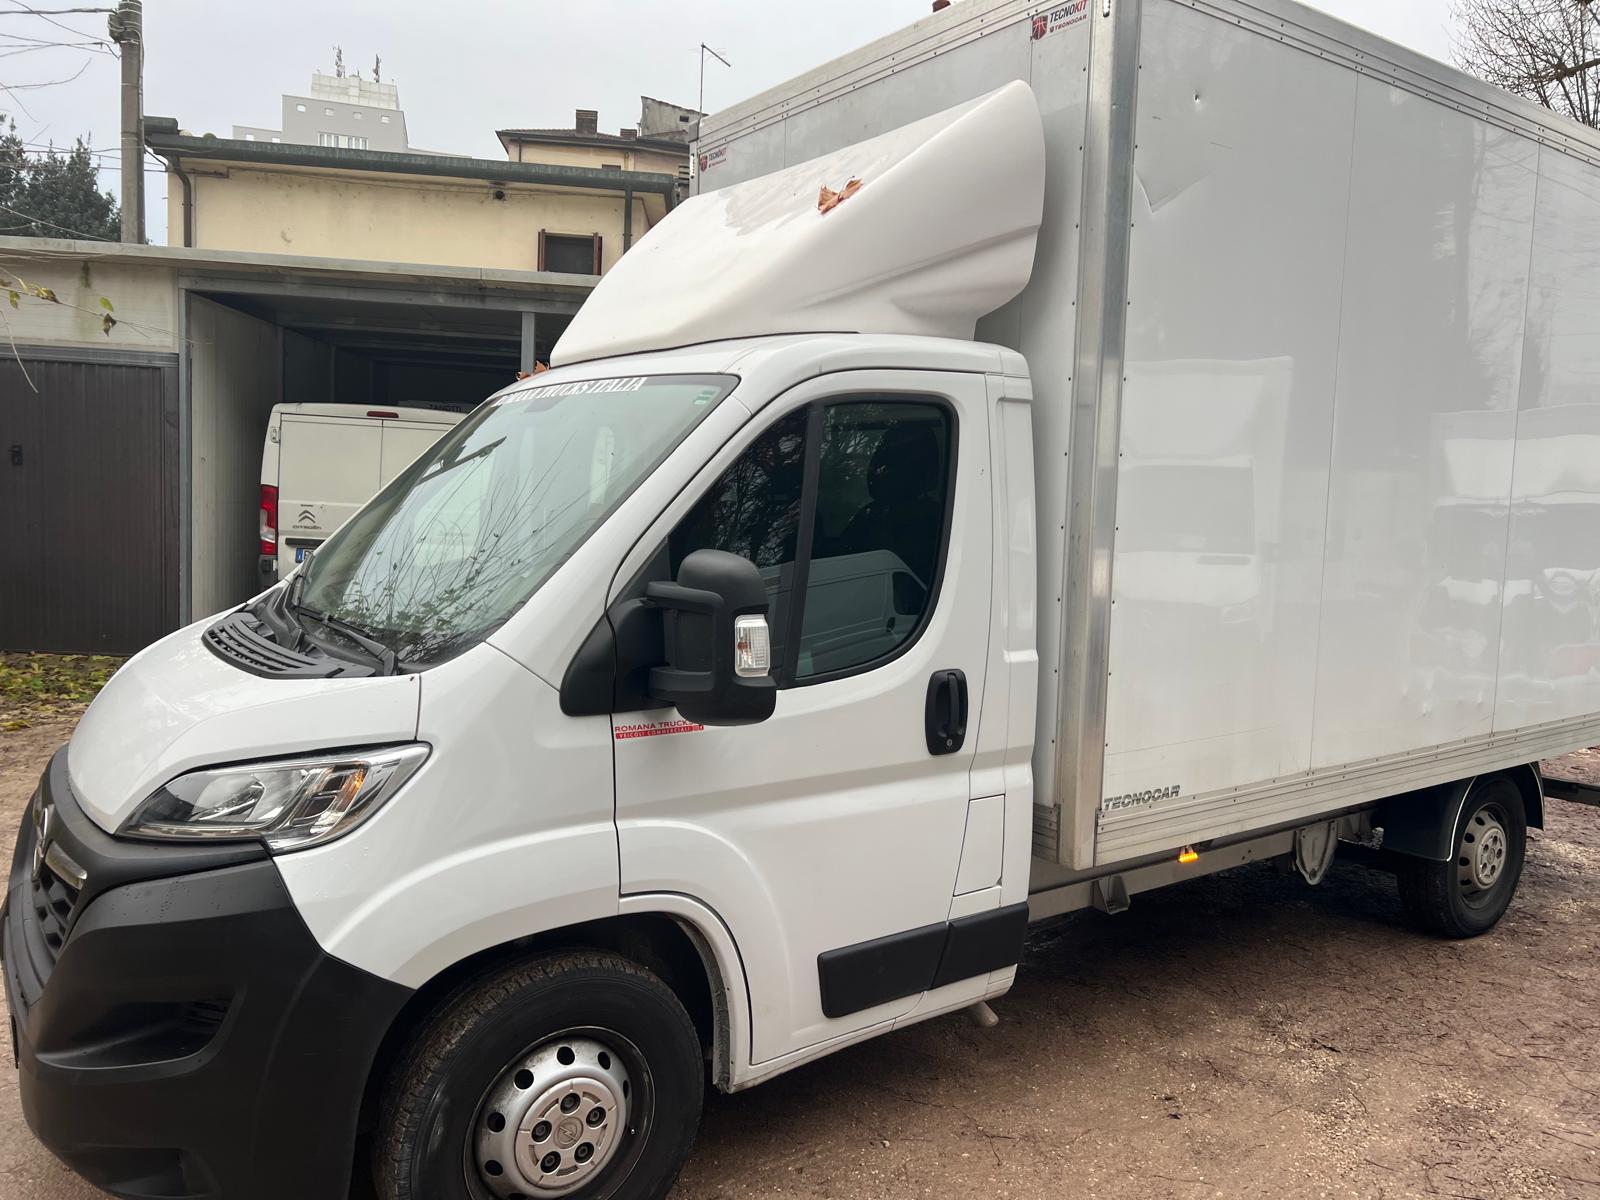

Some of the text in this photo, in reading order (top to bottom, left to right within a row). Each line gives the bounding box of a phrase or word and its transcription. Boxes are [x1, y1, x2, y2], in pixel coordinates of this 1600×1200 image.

[1050, 0, 1087, 23] TECNOKIT
[1055, 14, 1087, 30] TECNOCAR
[585, 377, 648, 394] ITALIA
[615, 723, 657, 732] ROMANA
[647, 726, 690, 736] COMMERCIALI
[1104, 785, 1180, 811] TECNOCAR
